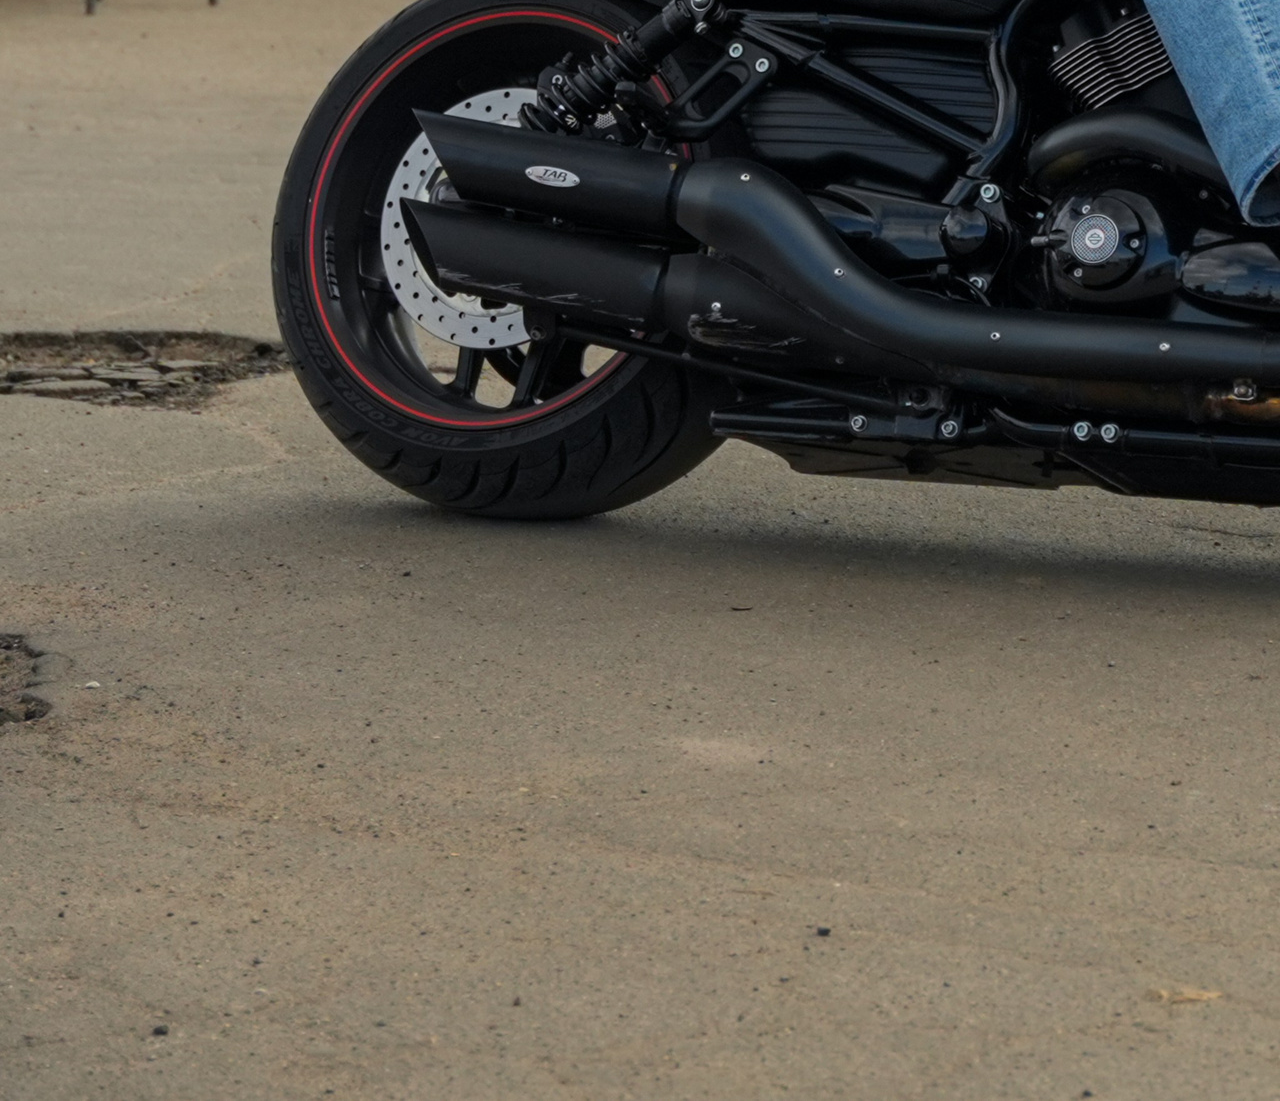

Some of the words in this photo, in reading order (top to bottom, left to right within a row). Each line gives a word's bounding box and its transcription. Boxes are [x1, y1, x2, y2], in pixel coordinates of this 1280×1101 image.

[288, 268, 331, 373] CHROME
[332, 375, 397, 431] COBRA
[401, 423, 468, 448] AVON
